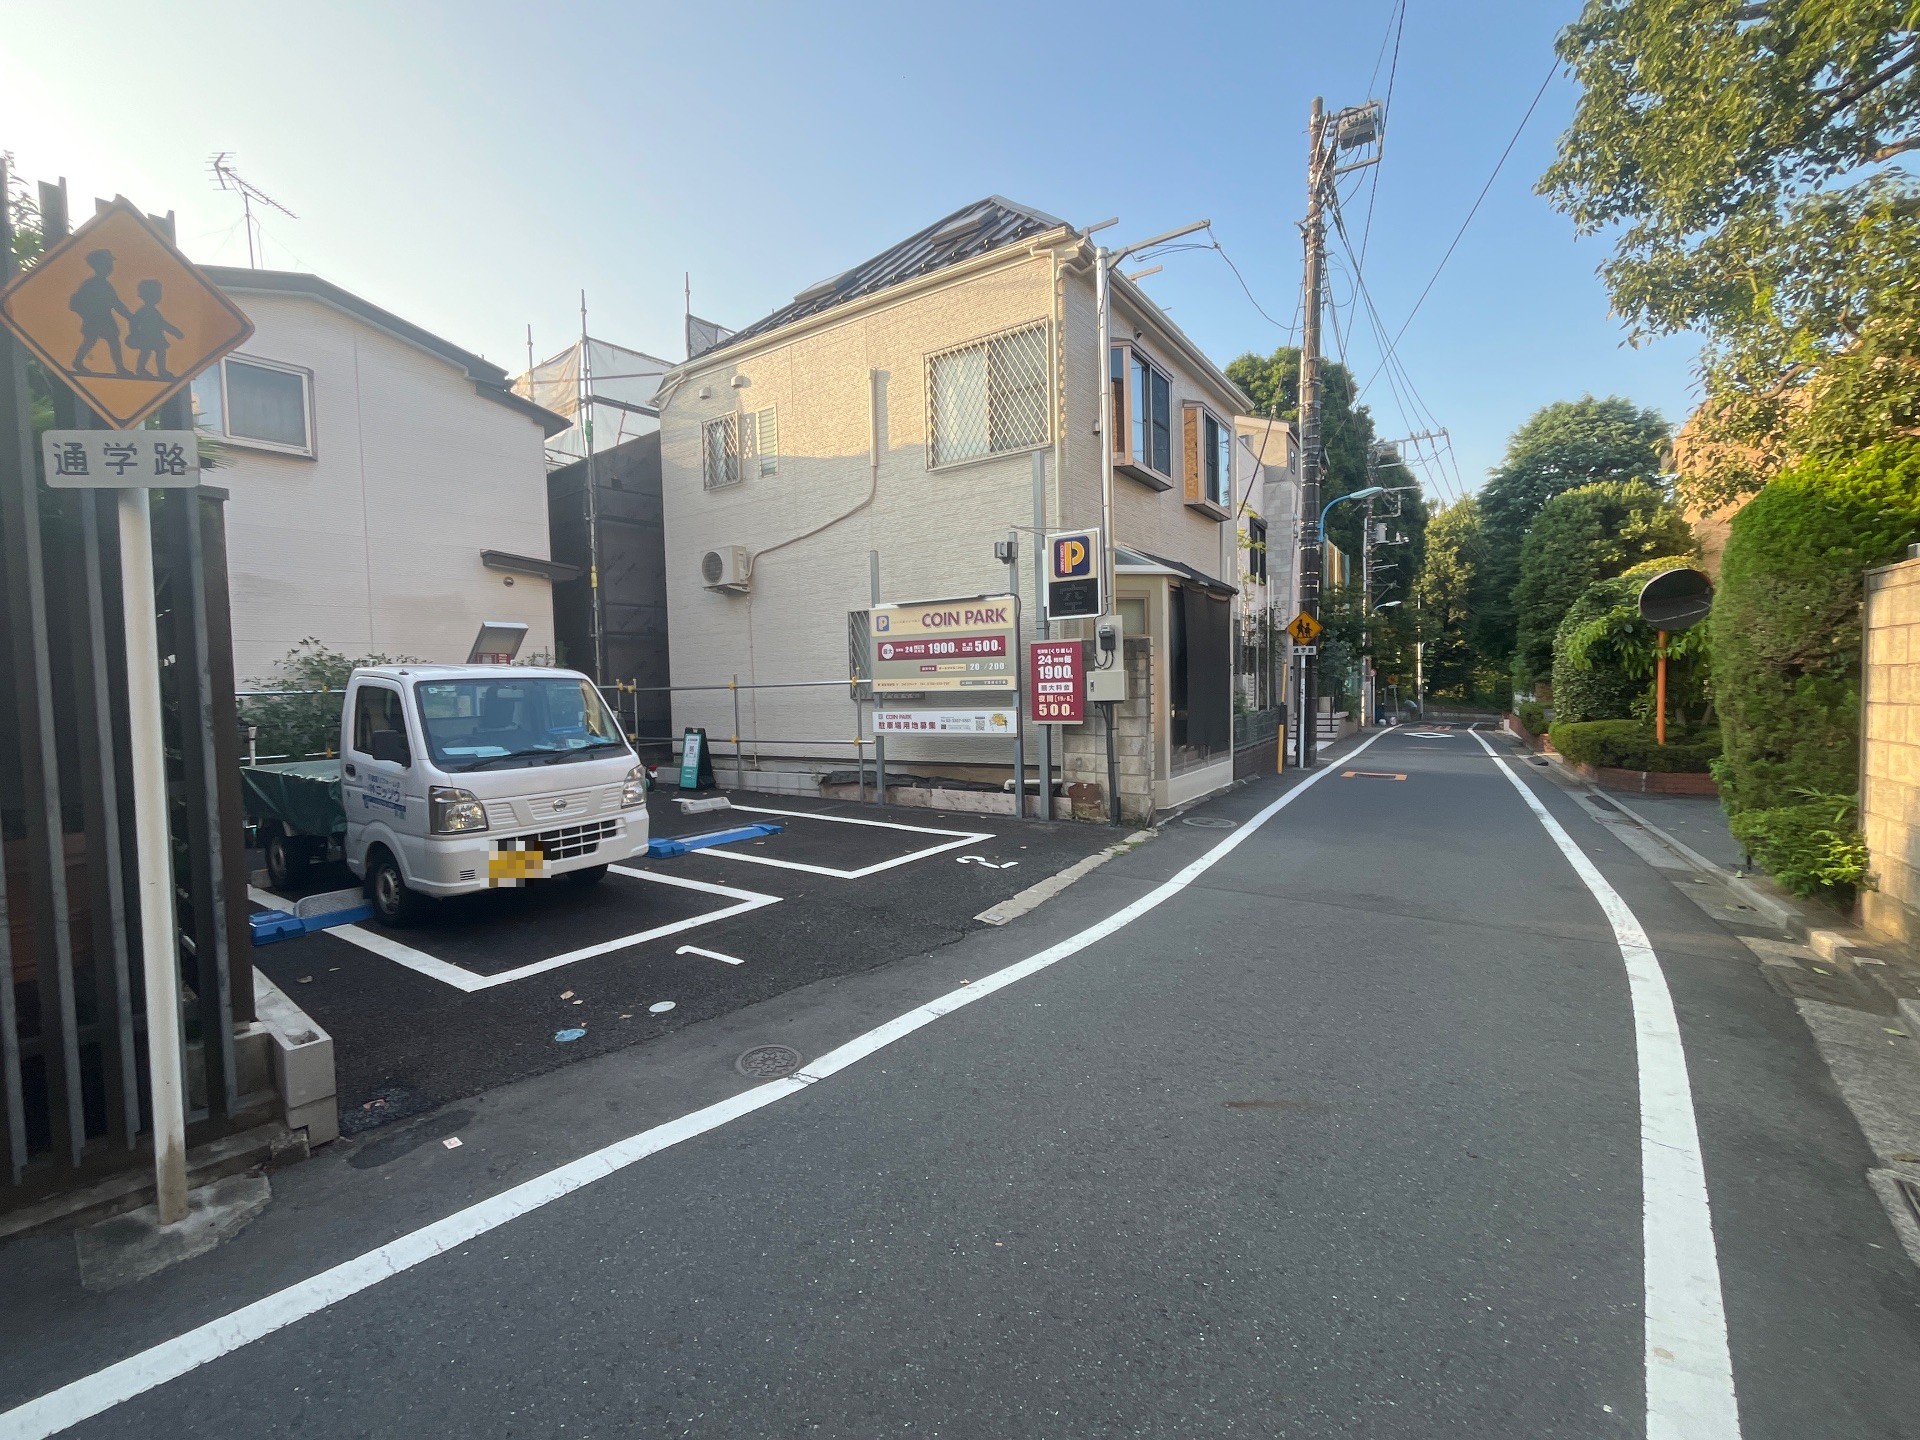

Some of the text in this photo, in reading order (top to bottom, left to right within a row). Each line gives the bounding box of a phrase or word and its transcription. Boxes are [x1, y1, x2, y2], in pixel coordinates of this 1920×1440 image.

[52, 442, 189, 476] 通学路
[1064, 541, 1085, 573] P
[921, 608, 1008, 628] COIN PARK
[928, 641, 959, 655] 1900
[974, 639, 1002, 652] 500
[956, 855, 1019, 869] 2
[675, 945, 745, 965] 1
